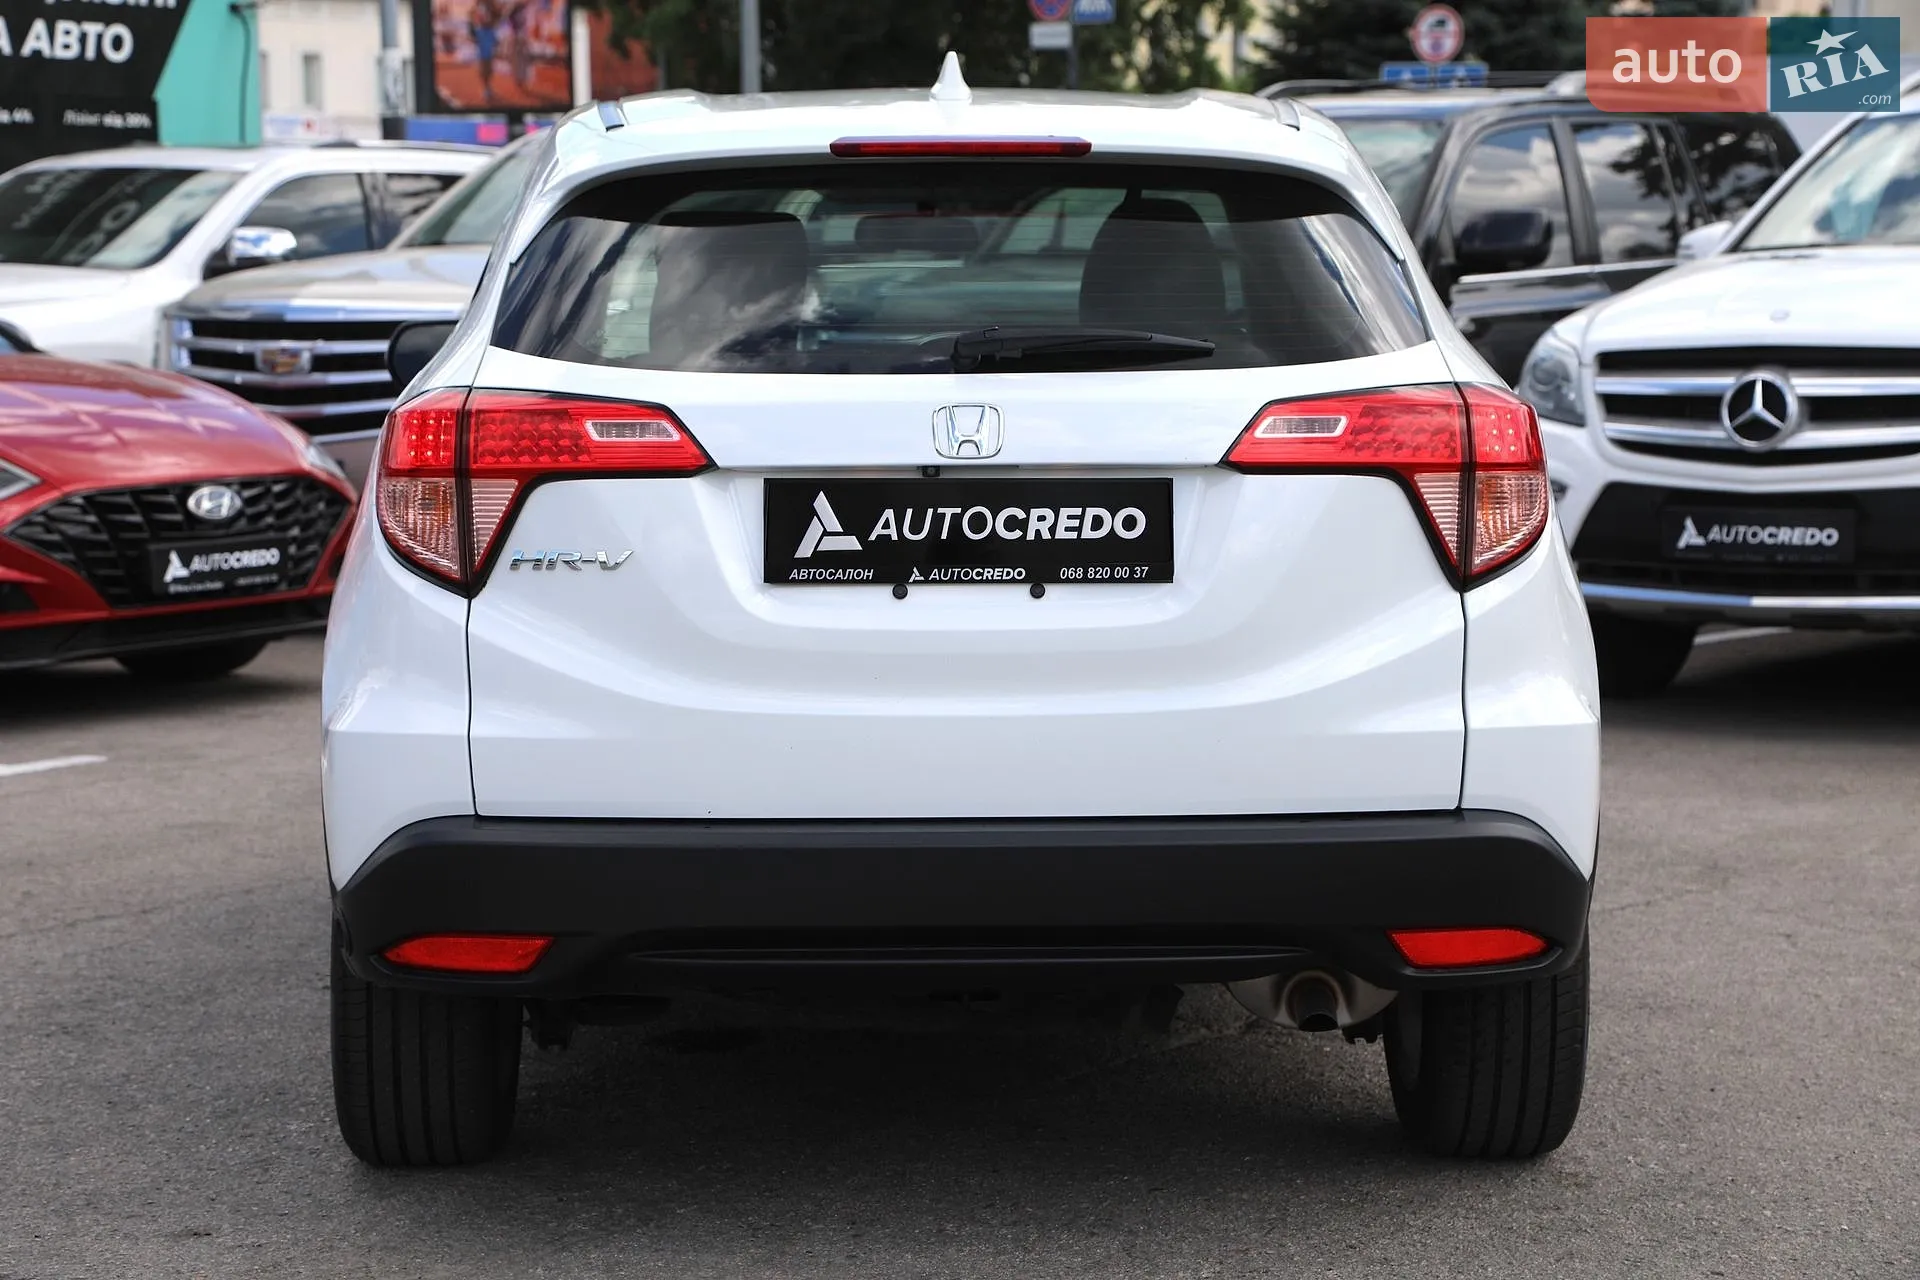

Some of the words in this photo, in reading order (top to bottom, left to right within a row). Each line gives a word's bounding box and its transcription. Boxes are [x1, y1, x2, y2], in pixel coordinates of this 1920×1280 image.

[20, 18, 134, 63] АВТО
[868, 506, 1146, 541] AUTOCREDO
[1706, 523, 1840, 547] AUTOCREDO
[189, 548, 281, 573] AUTOCREDO
[510, 549, 633, 571] HR-V
[789, 568, 873, 580] АВТОСАЛОН
[929, 567, 1026, 581] AUTOCREDO
[1060, 567, 1084, 579] 068
[1087, 567, 1111, 579] 820
[1114, 566, 1130, 579] 00
[1133, 566, 1149, 578] 37
